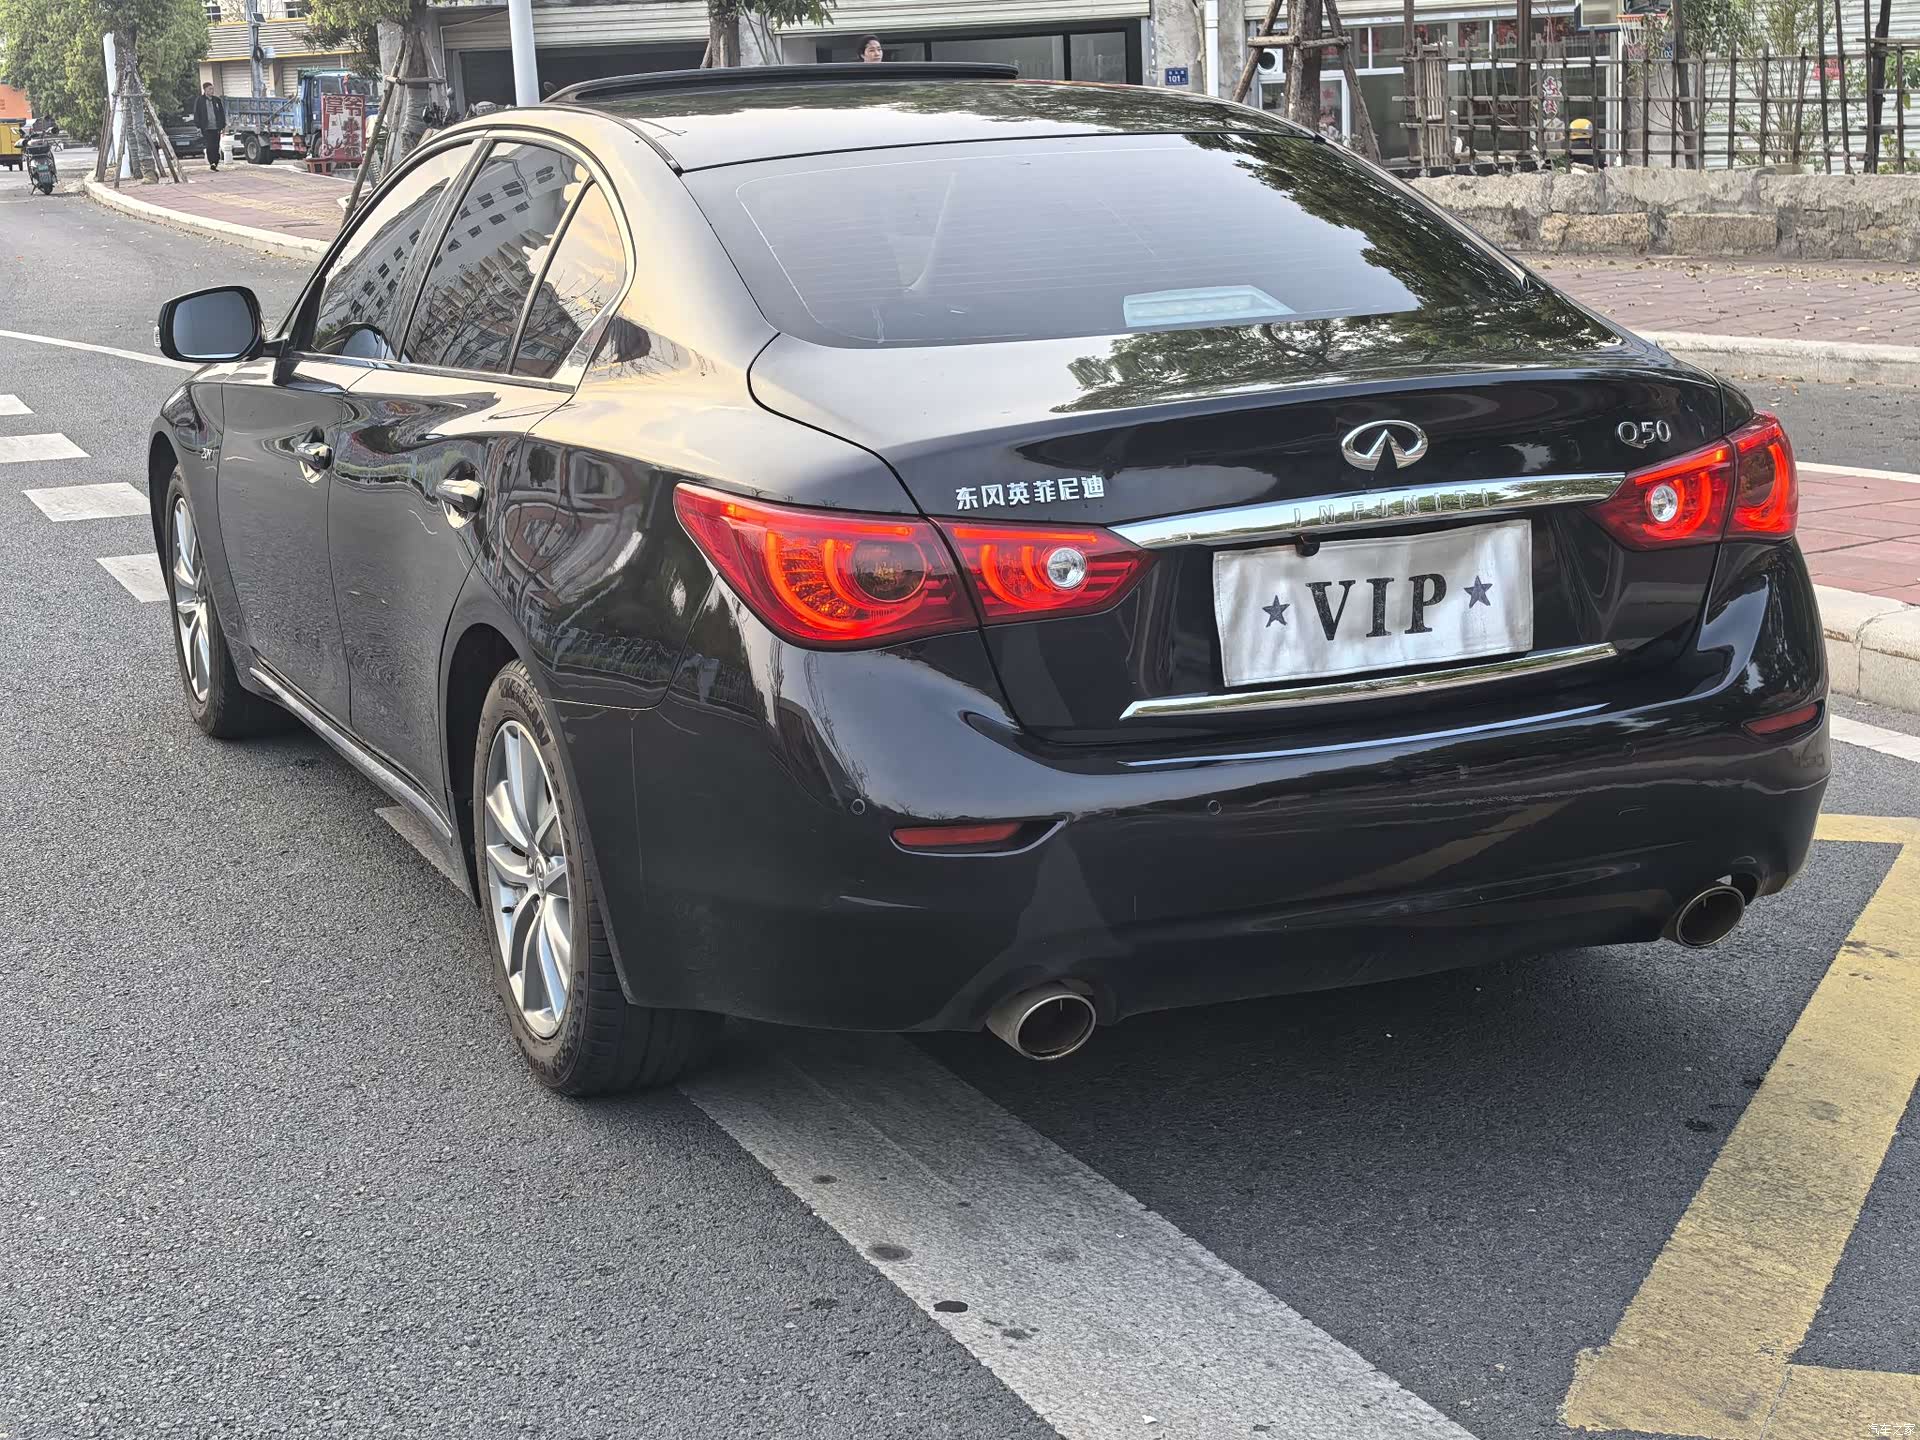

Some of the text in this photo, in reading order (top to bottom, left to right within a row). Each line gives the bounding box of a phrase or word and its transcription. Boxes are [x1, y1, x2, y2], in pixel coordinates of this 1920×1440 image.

[1168, 75, 1181, 83] 101
[1617, 419, 1672, 449] Q50
[955, 474, 1105, 510] 东风英菲尼迪
[1293, 487, 1490, 528] INFINITI
[1305, 573, 1447, 641] VIP
